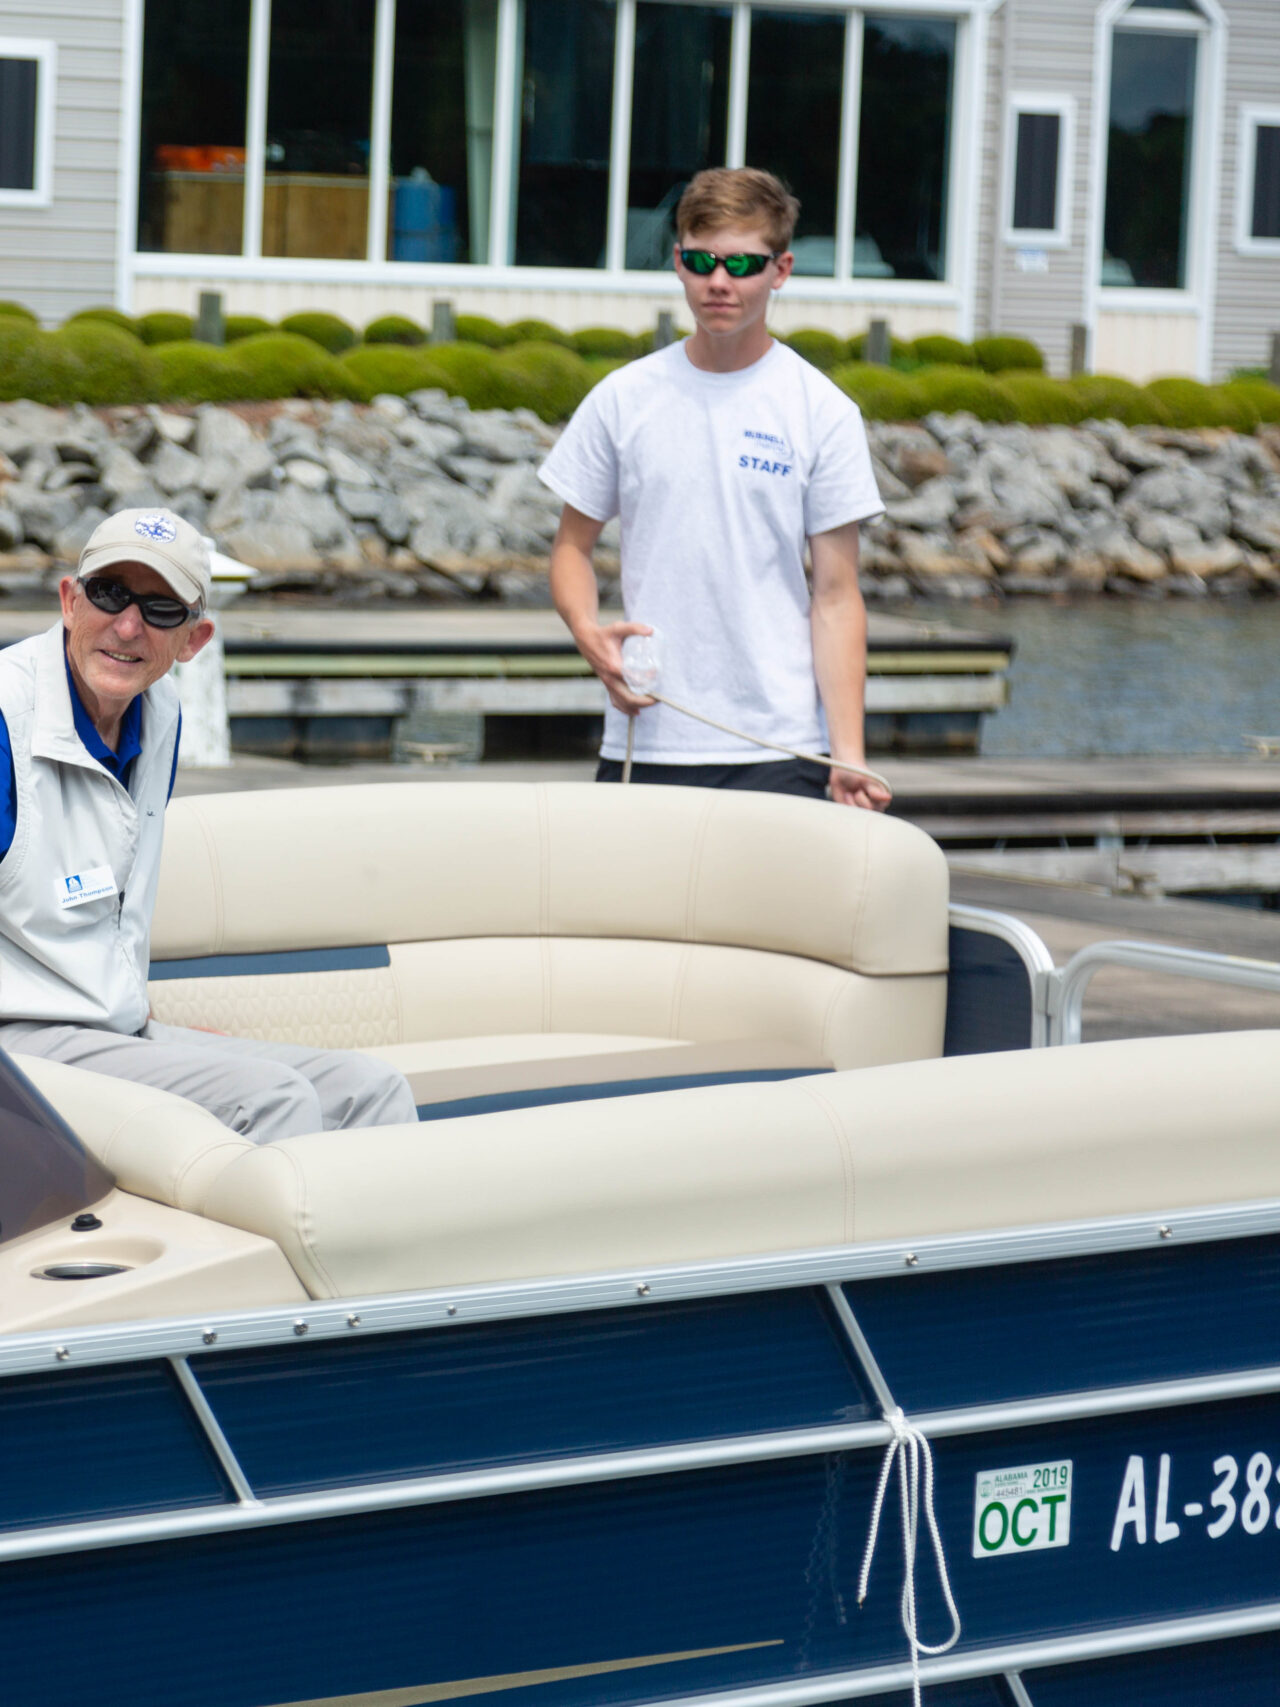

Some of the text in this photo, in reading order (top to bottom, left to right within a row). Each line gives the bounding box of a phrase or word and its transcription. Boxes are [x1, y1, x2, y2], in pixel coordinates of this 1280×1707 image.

[739, 454, 792, 476] STAFF
[995, 1471, 1029, 1482] ALABAMA
[1033, 1465, 1068, 1488] 2019
[1110, 1451, 1280, 1552] AL-38
[978, 1493, 1067, 1552] OCT
